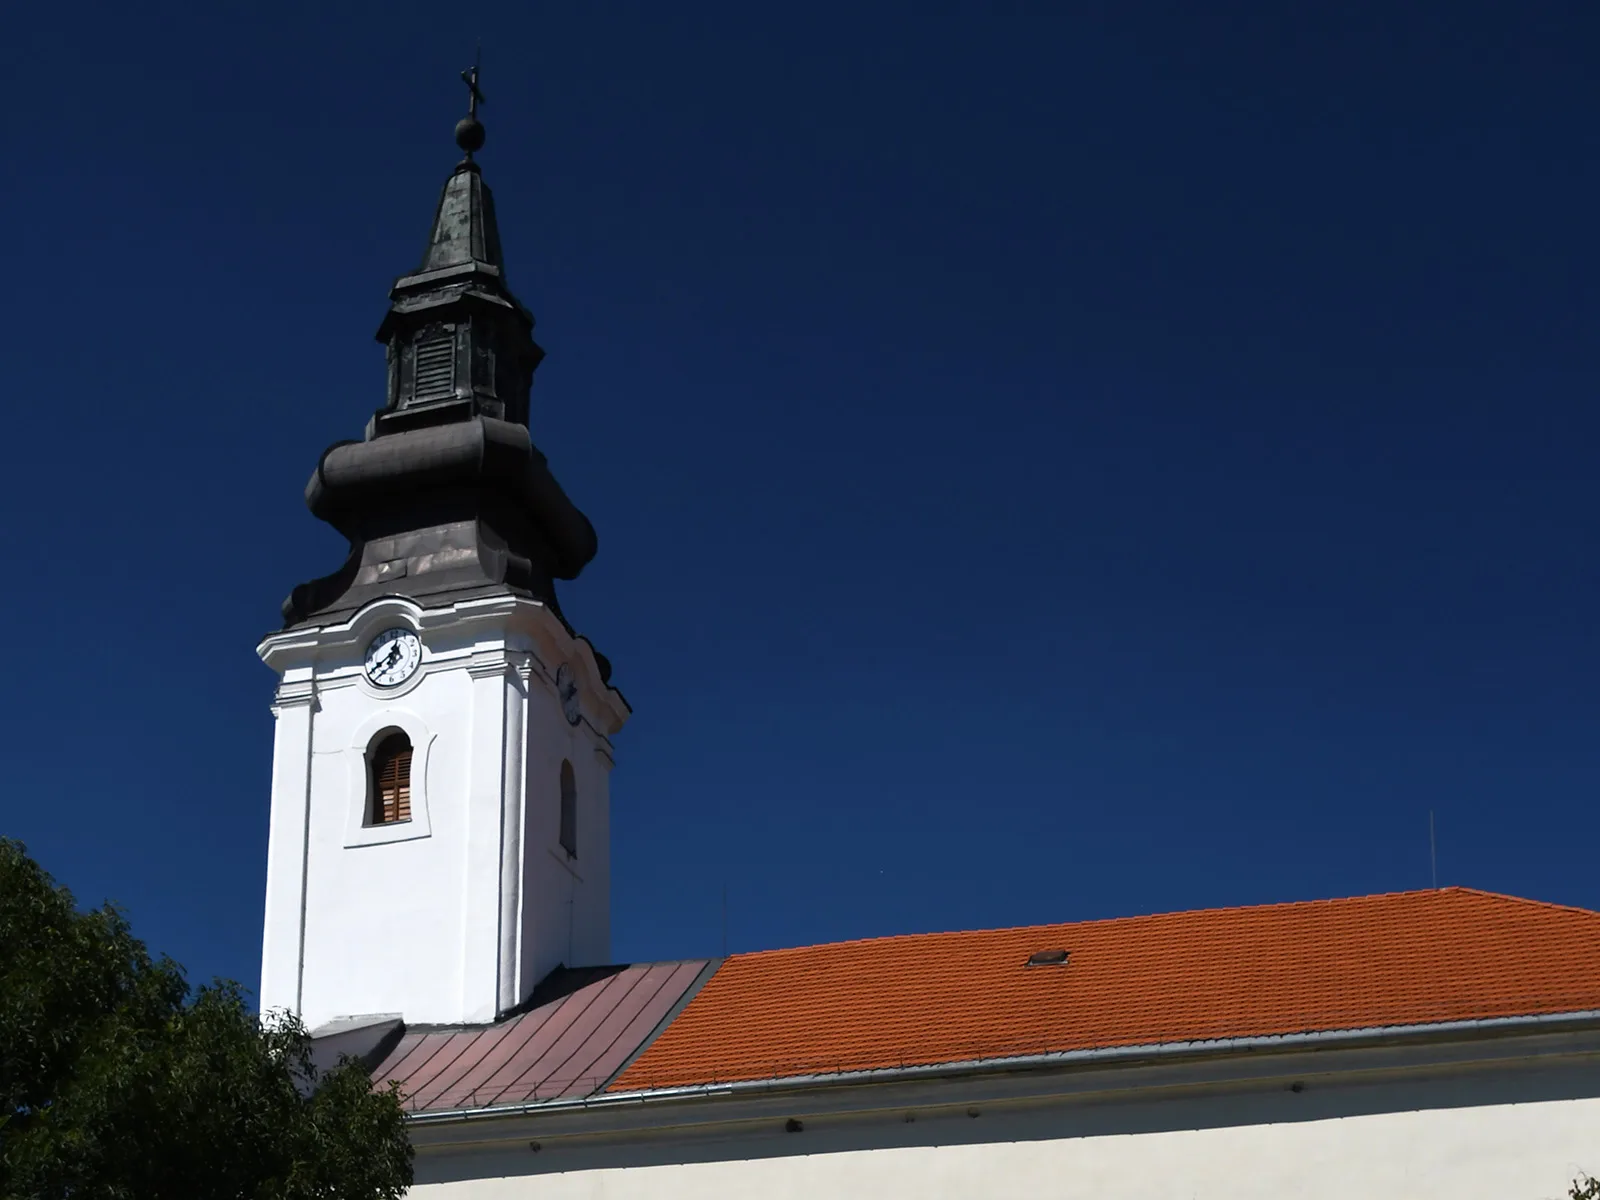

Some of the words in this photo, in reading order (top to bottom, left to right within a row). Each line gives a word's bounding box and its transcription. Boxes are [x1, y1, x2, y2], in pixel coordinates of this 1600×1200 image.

[412, 649, 417, 657] 3
[409, 661, 414, 669] 4
[400, 670, 405, 679] 5
